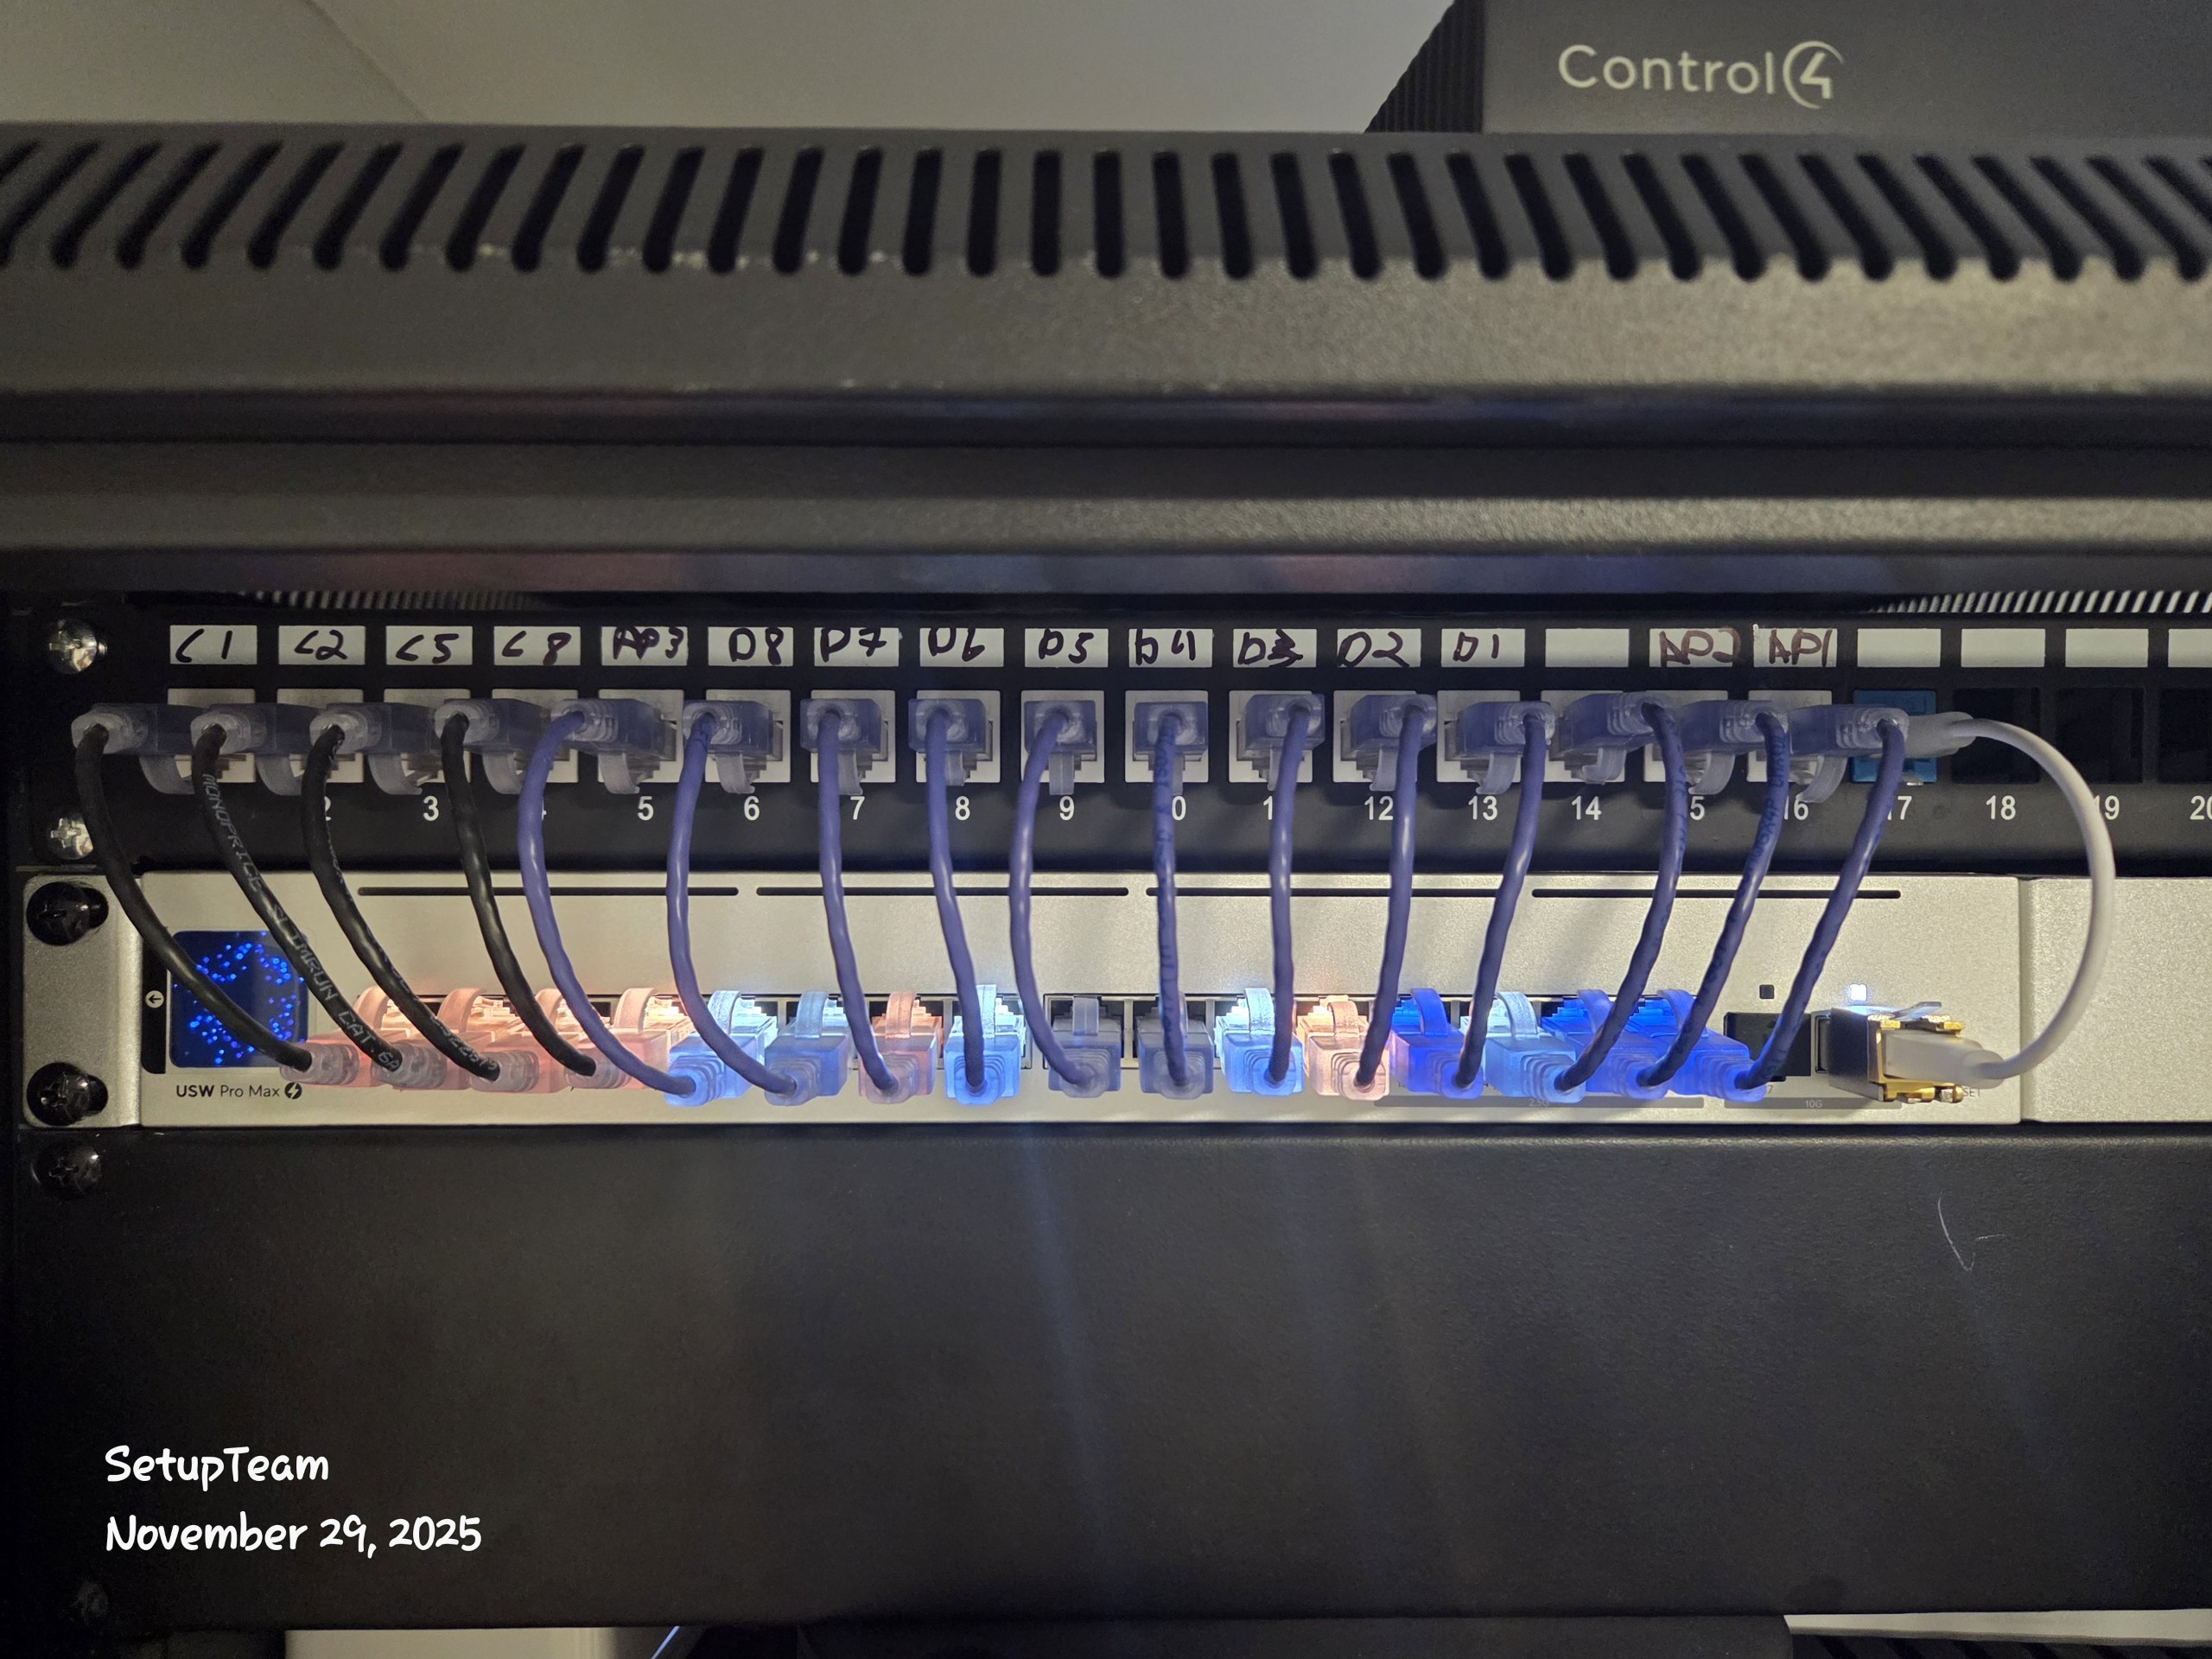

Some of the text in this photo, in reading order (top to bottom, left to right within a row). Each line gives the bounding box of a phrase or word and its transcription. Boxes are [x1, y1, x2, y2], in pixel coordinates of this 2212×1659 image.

[175, 628, 232, 663] C1
[395, 633, 460, 664] C5
[728, 627, 784, 665] D8
[927, 627, 985, 662] D6
[1038, 627, 1094, 664] D5
[1338, 632, 1410, 667] D2
[1452, 632, 1499, 661] D1
[1769, 628, 1833, 667] AP1
[423, 795, 440, 821] 3
[638, 796, 655, 821] 5
[743, 796, 760, 821] 6
[850, 796, 865, 820] 7
[955, 796, 970, 820] 8
[1059, 796, 1075, 821] 9
[1171, 796, 1186, 820] 0
[1364, 796, 1394, 820] 12
[1468, 796, 1498, 820] 13
[1571, 796, 1602, 820] 14
[1689, 796, 1705, 821] 5
[1887, 796, 1912, 820] 7
[1986, 795, 2017, 820] 18
[202, 773, 264, 893] MONOPRICE
[175, 1084, 281, 1097] USW Pro Max
[1962, 1087, 1982, 1097] SET
[1804, 1100, 1823, 1109] 10G
